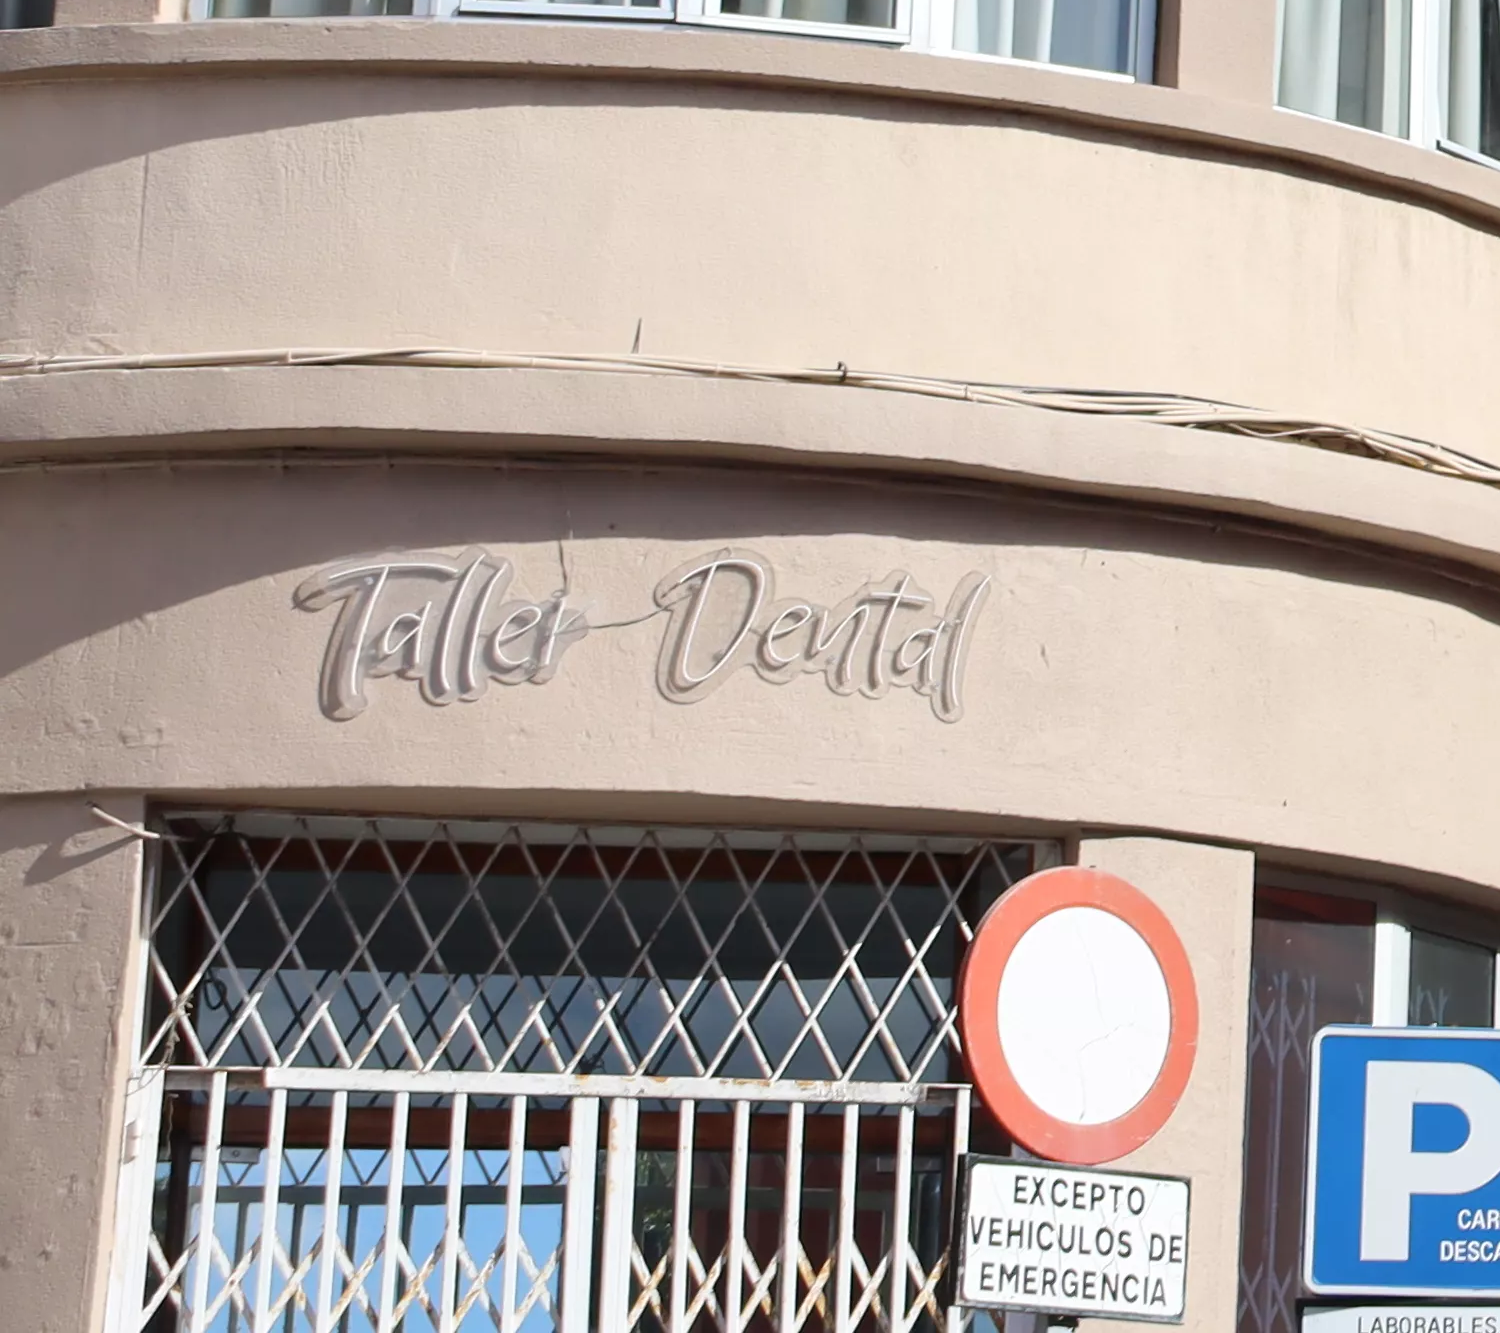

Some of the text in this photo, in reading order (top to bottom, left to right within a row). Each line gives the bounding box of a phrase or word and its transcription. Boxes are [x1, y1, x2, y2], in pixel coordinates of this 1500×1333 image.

[300, 547, 991, 721] Taller Dental
[1013, 1174, 1146, 1216] EXCEPTO
[970, 1215, 1183, 1264] VEHICULOS DE
[979, 1262, 1167, 1306] EMERGENCIA
[1357, 1316, 1498, 1333] LABORABLES
